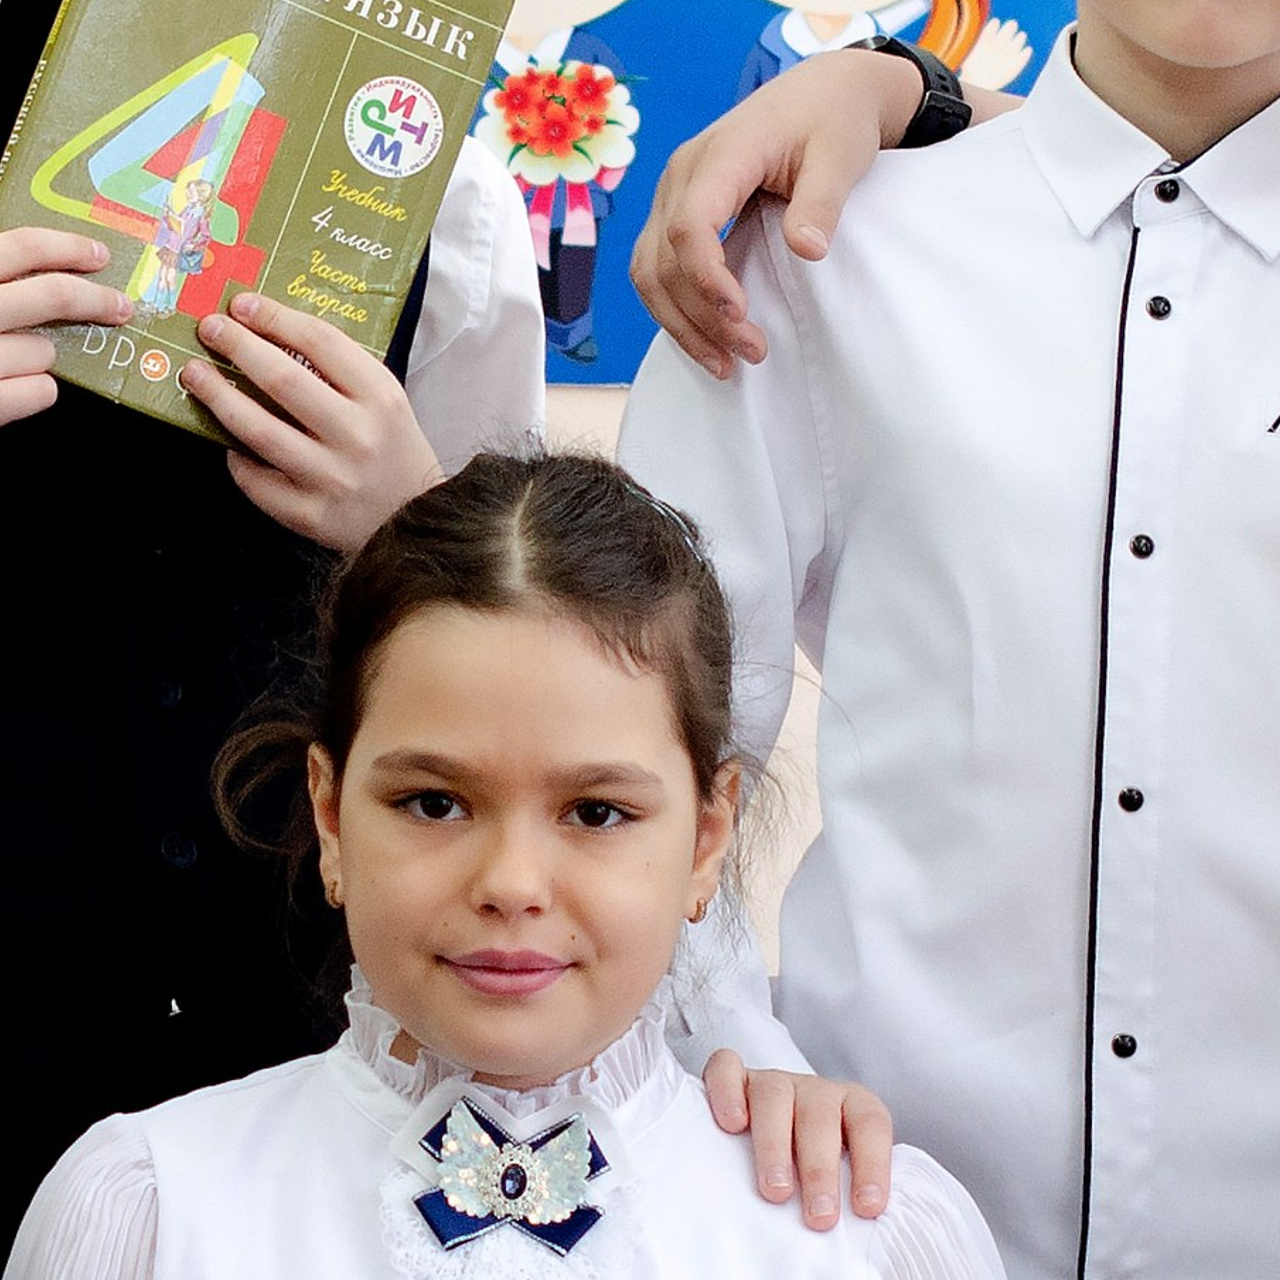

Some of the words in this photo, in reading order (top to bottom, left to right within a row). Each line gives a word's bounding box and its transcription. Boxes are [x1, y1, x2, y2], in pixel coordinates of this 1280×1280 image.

[31, 33, 288, 320] 4
[322, 170, 407, 222] Учебник
[311, 206, 334, 232] 4
[329, 227, 393, 260] класс
[309, 249, 368, 293] Часть
[287, 274, 368, 323] вторая
